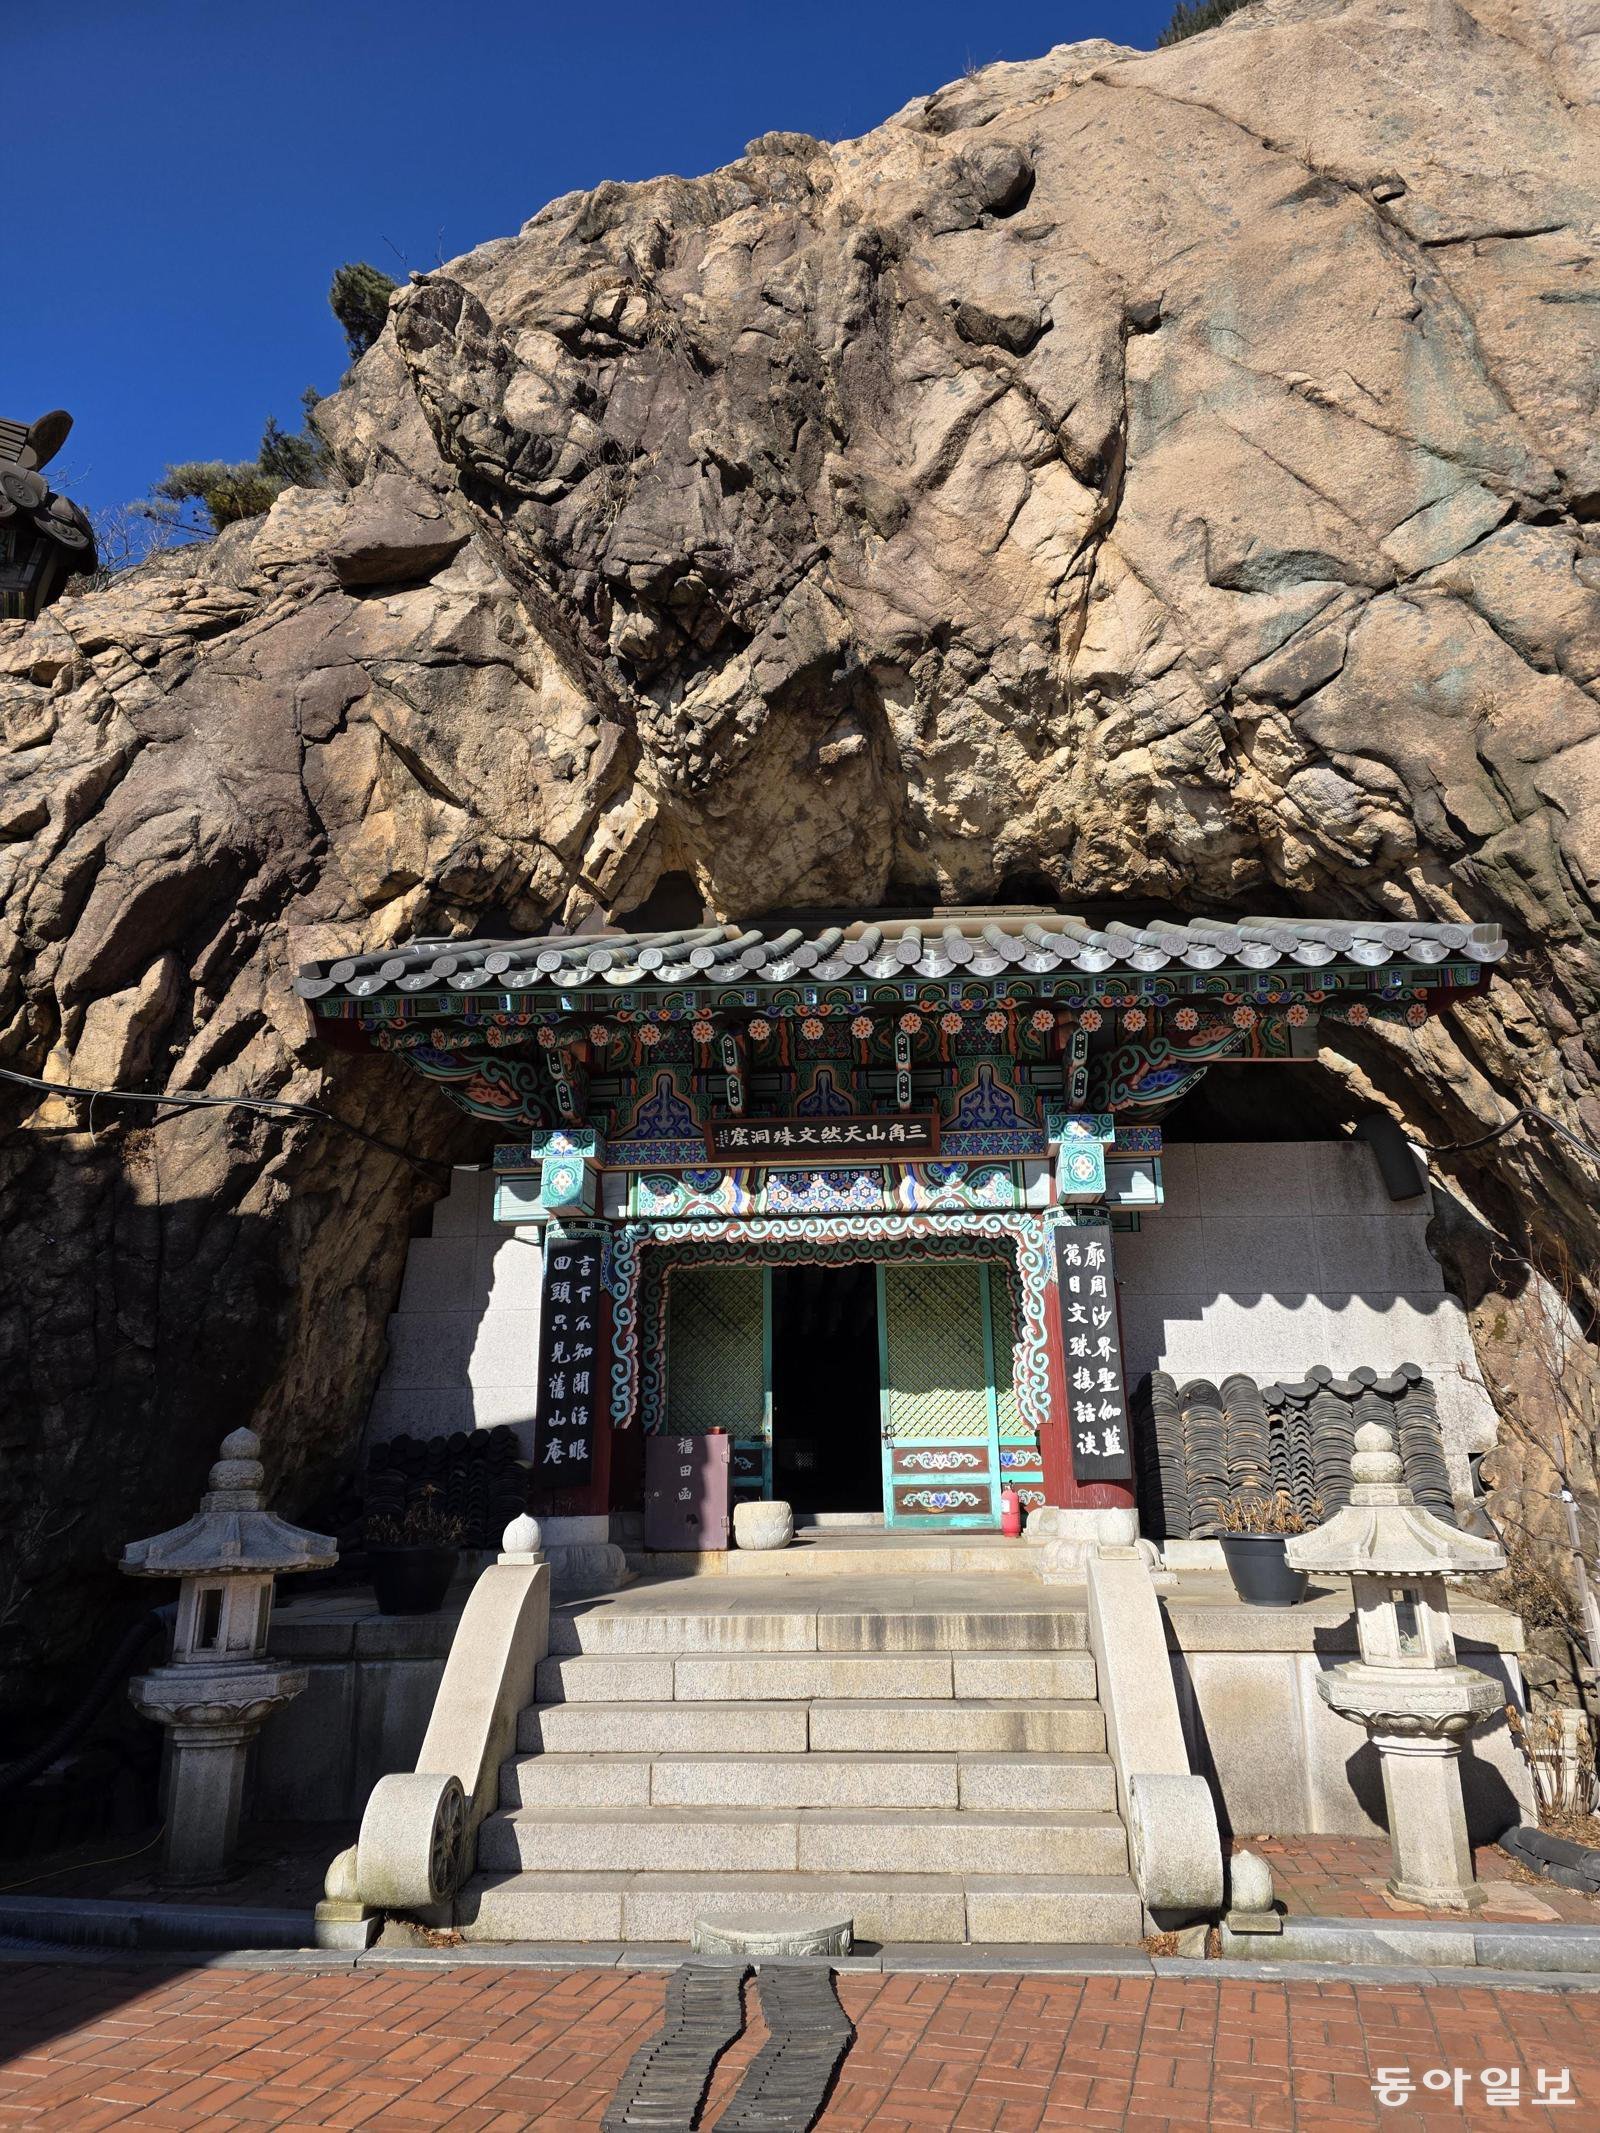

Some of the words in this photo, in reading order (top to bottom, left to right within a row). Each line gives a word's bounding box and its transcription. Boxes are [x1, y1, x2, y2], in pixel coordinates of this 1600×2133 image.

[730, 1123, 927, 1146] 三角山天然文殊洞窟
[568, 1255, 595, 1461] 言下不知開活眼
[1083, 1241, 1125, 1457] 廓周沙界聖伽藍
[677, 1437, 695, 1501] 福田函
